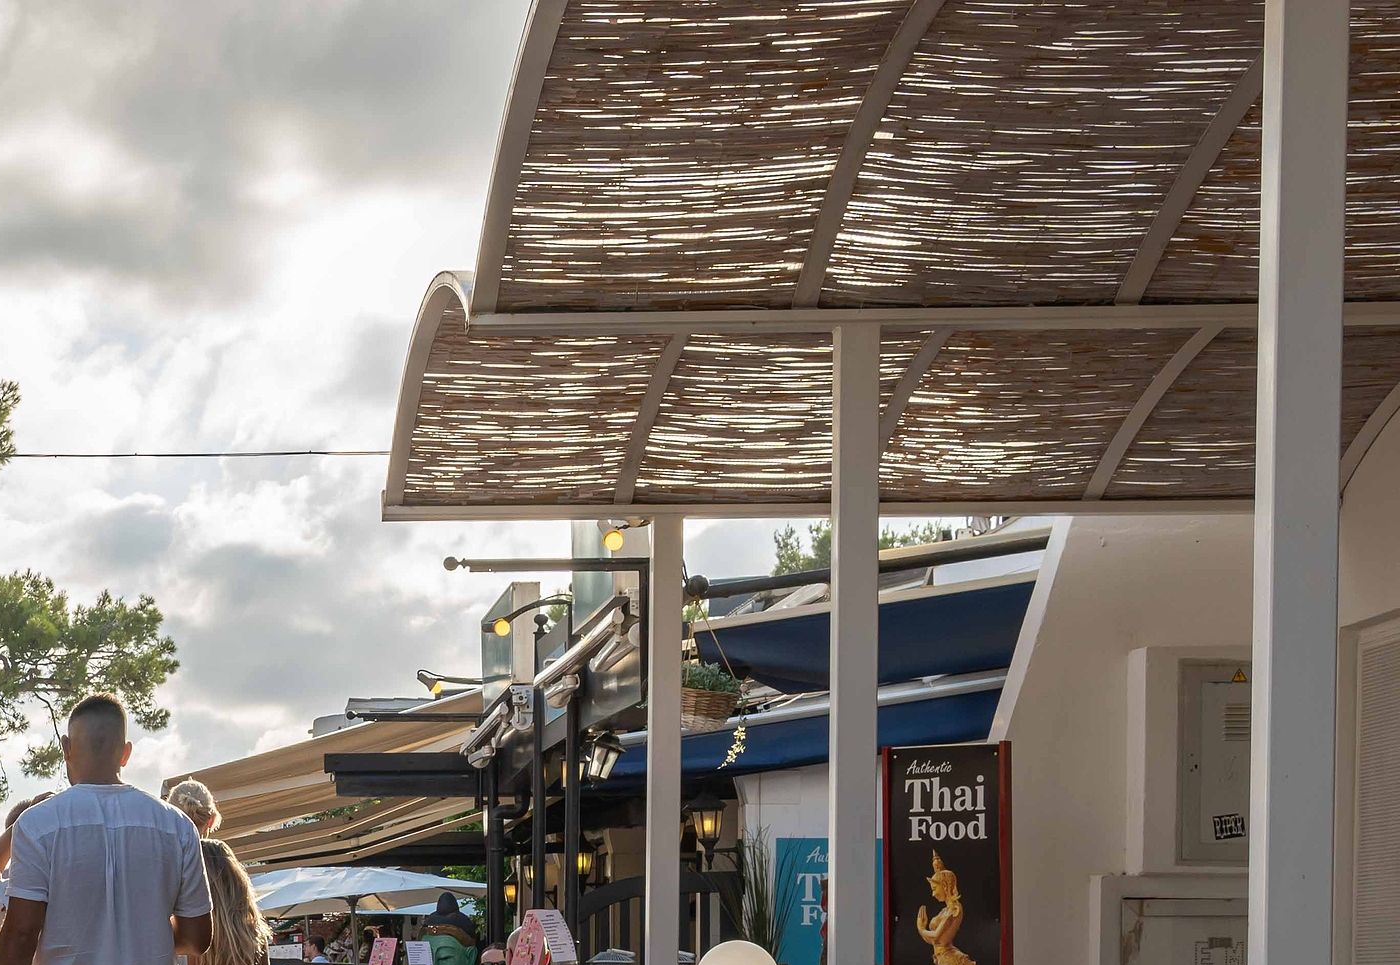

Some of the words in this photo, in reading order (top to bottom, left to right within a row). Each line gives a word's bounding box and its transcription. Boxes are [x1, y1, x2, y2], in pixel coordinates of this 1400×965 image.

[905, 759, 953, 775] Authentic
[904, 774, 987, 813] Thai
[908, 812, 988, 841] Food
